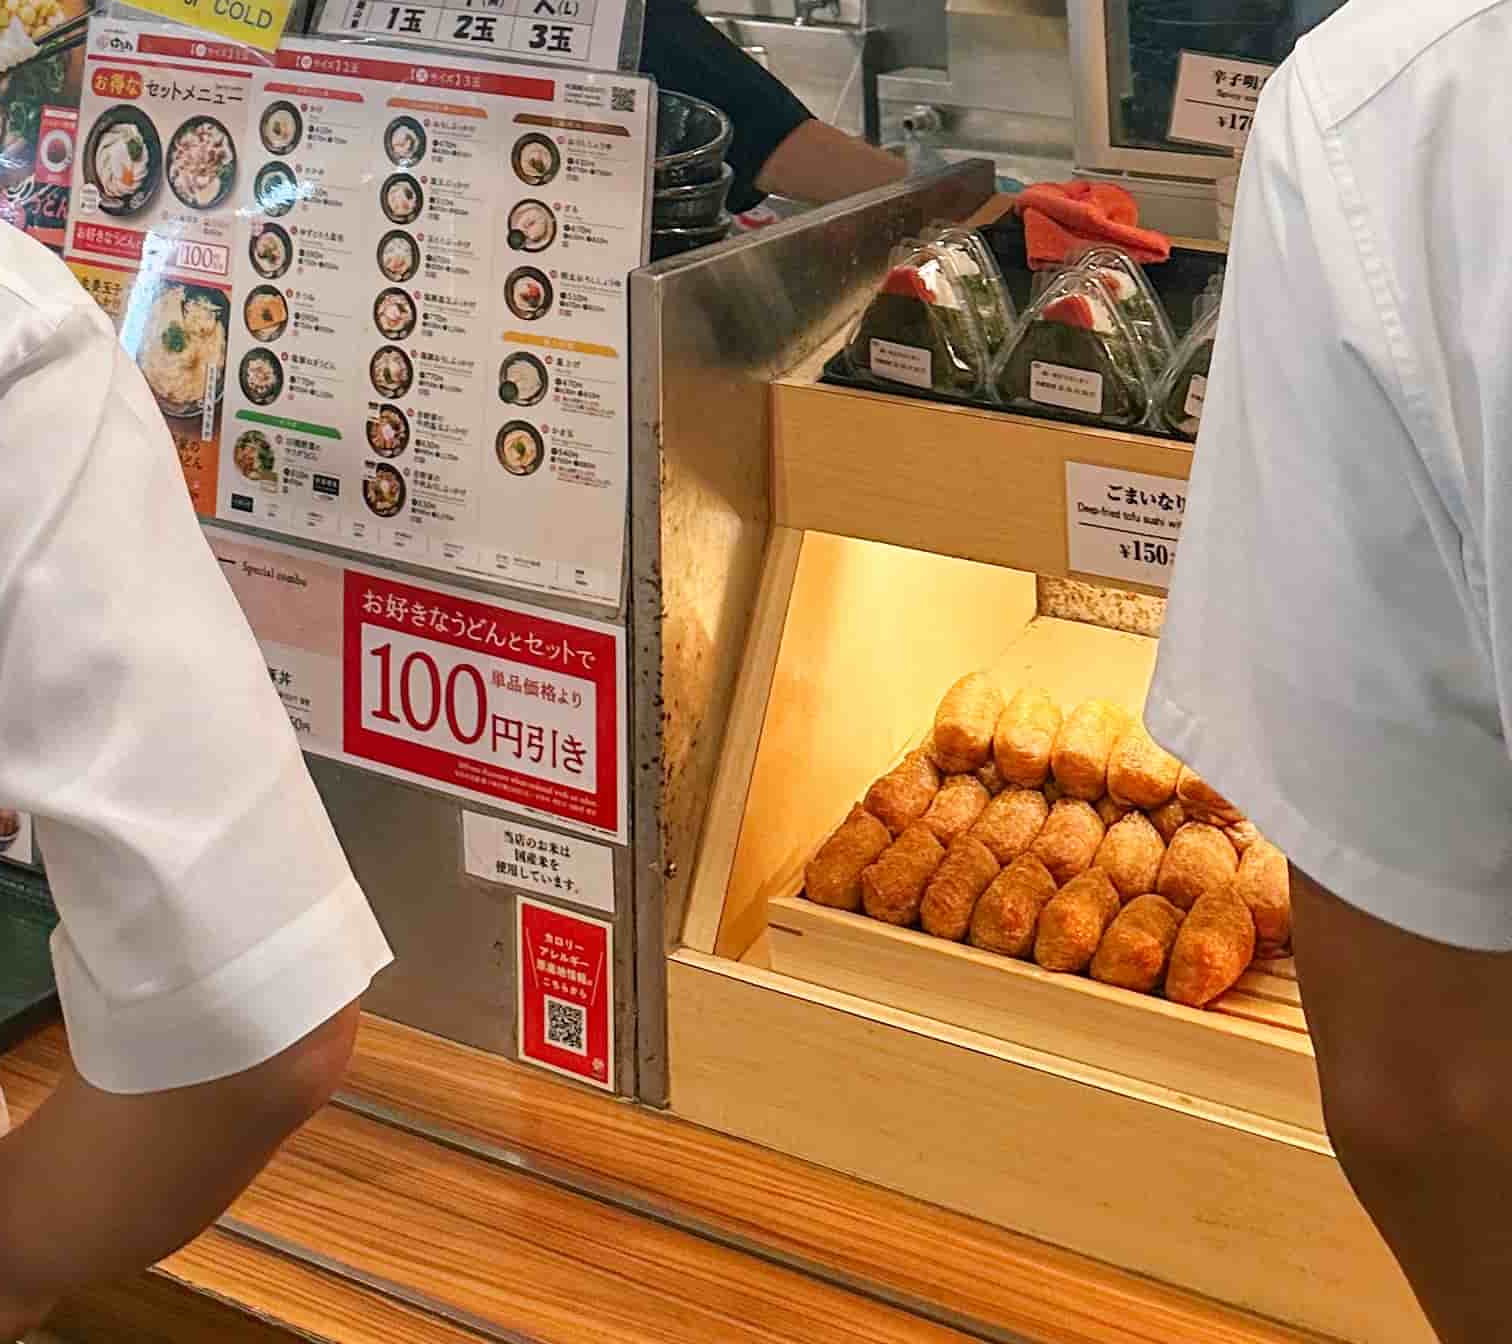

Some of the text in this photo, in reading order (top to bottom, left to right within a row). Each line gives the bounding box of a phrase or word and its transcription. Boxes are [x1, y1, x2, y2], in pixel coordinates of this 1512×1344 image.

[386, 8, 425, 33] 1玉
[453, 15, 497, 43] 2玉
[529, 24, 574, 53] 3玉
[1107, 484, 1187, 515] ごまいなり
[361, 587, 597, 671] お好きなうどんとセットで
[369, 641, 487, 746] 100
[491, 669, 584, 710] 単品価格より
[491, 712, 588, 775] 円引き
